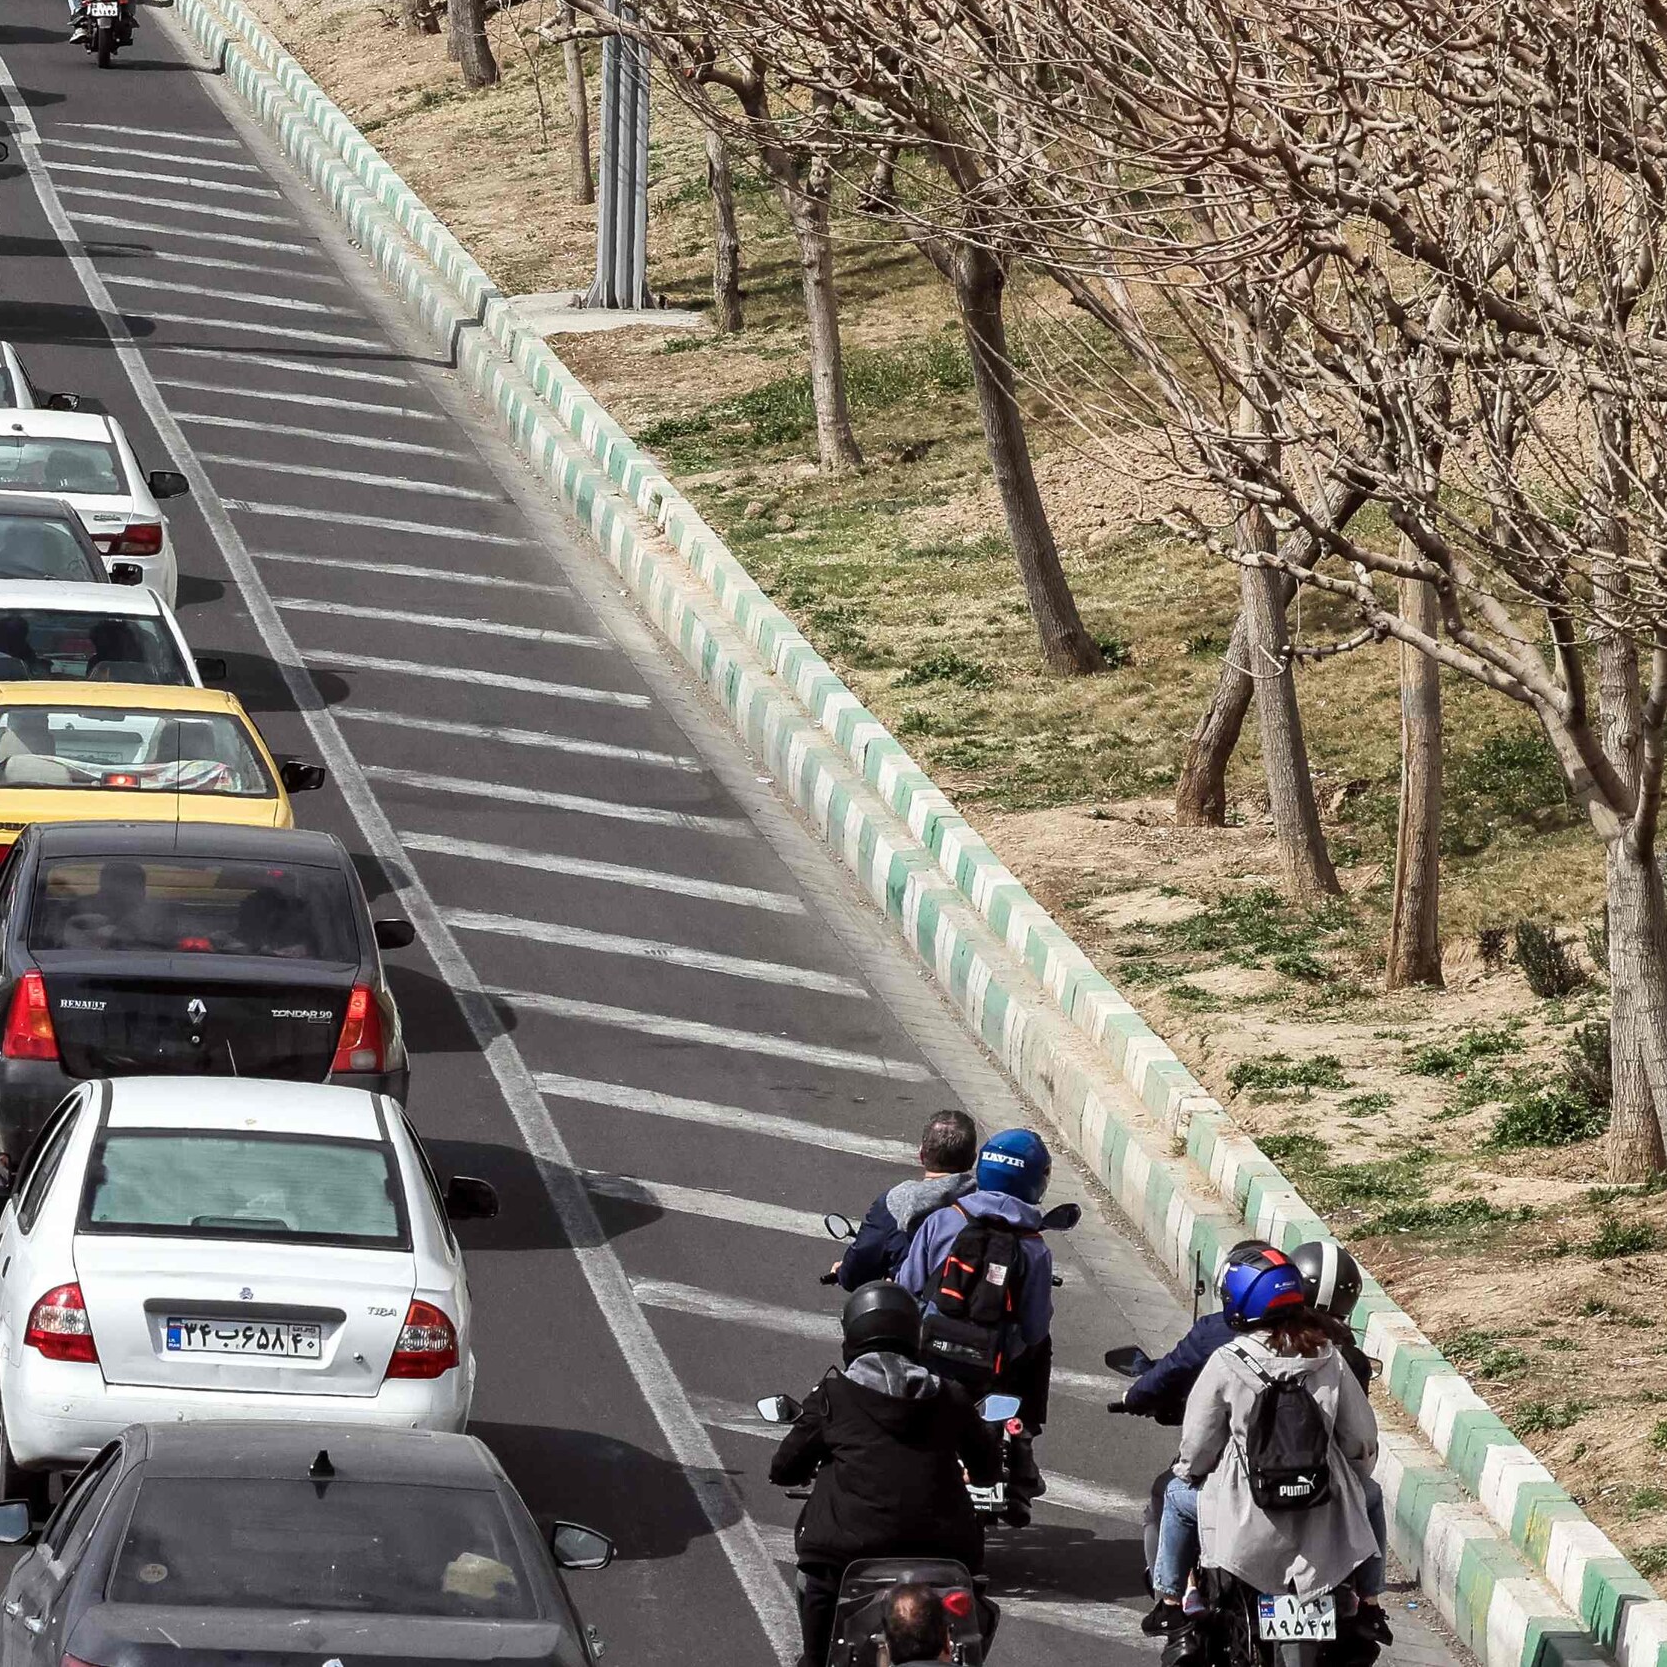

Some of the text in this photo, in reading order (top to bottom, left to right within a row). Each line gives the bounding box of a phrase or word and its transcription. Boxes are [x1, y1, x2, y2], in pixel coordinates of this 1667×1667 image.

[59, 999, 107, 1012] RENAULT
[981, 1150, 1025, 1169] KAVIR
[367, 1306, 397, 1317] TIBA
[1243, 1355, 1264, 1375] PUMA
[1279, 1484, 1310, 1497] PUMA
